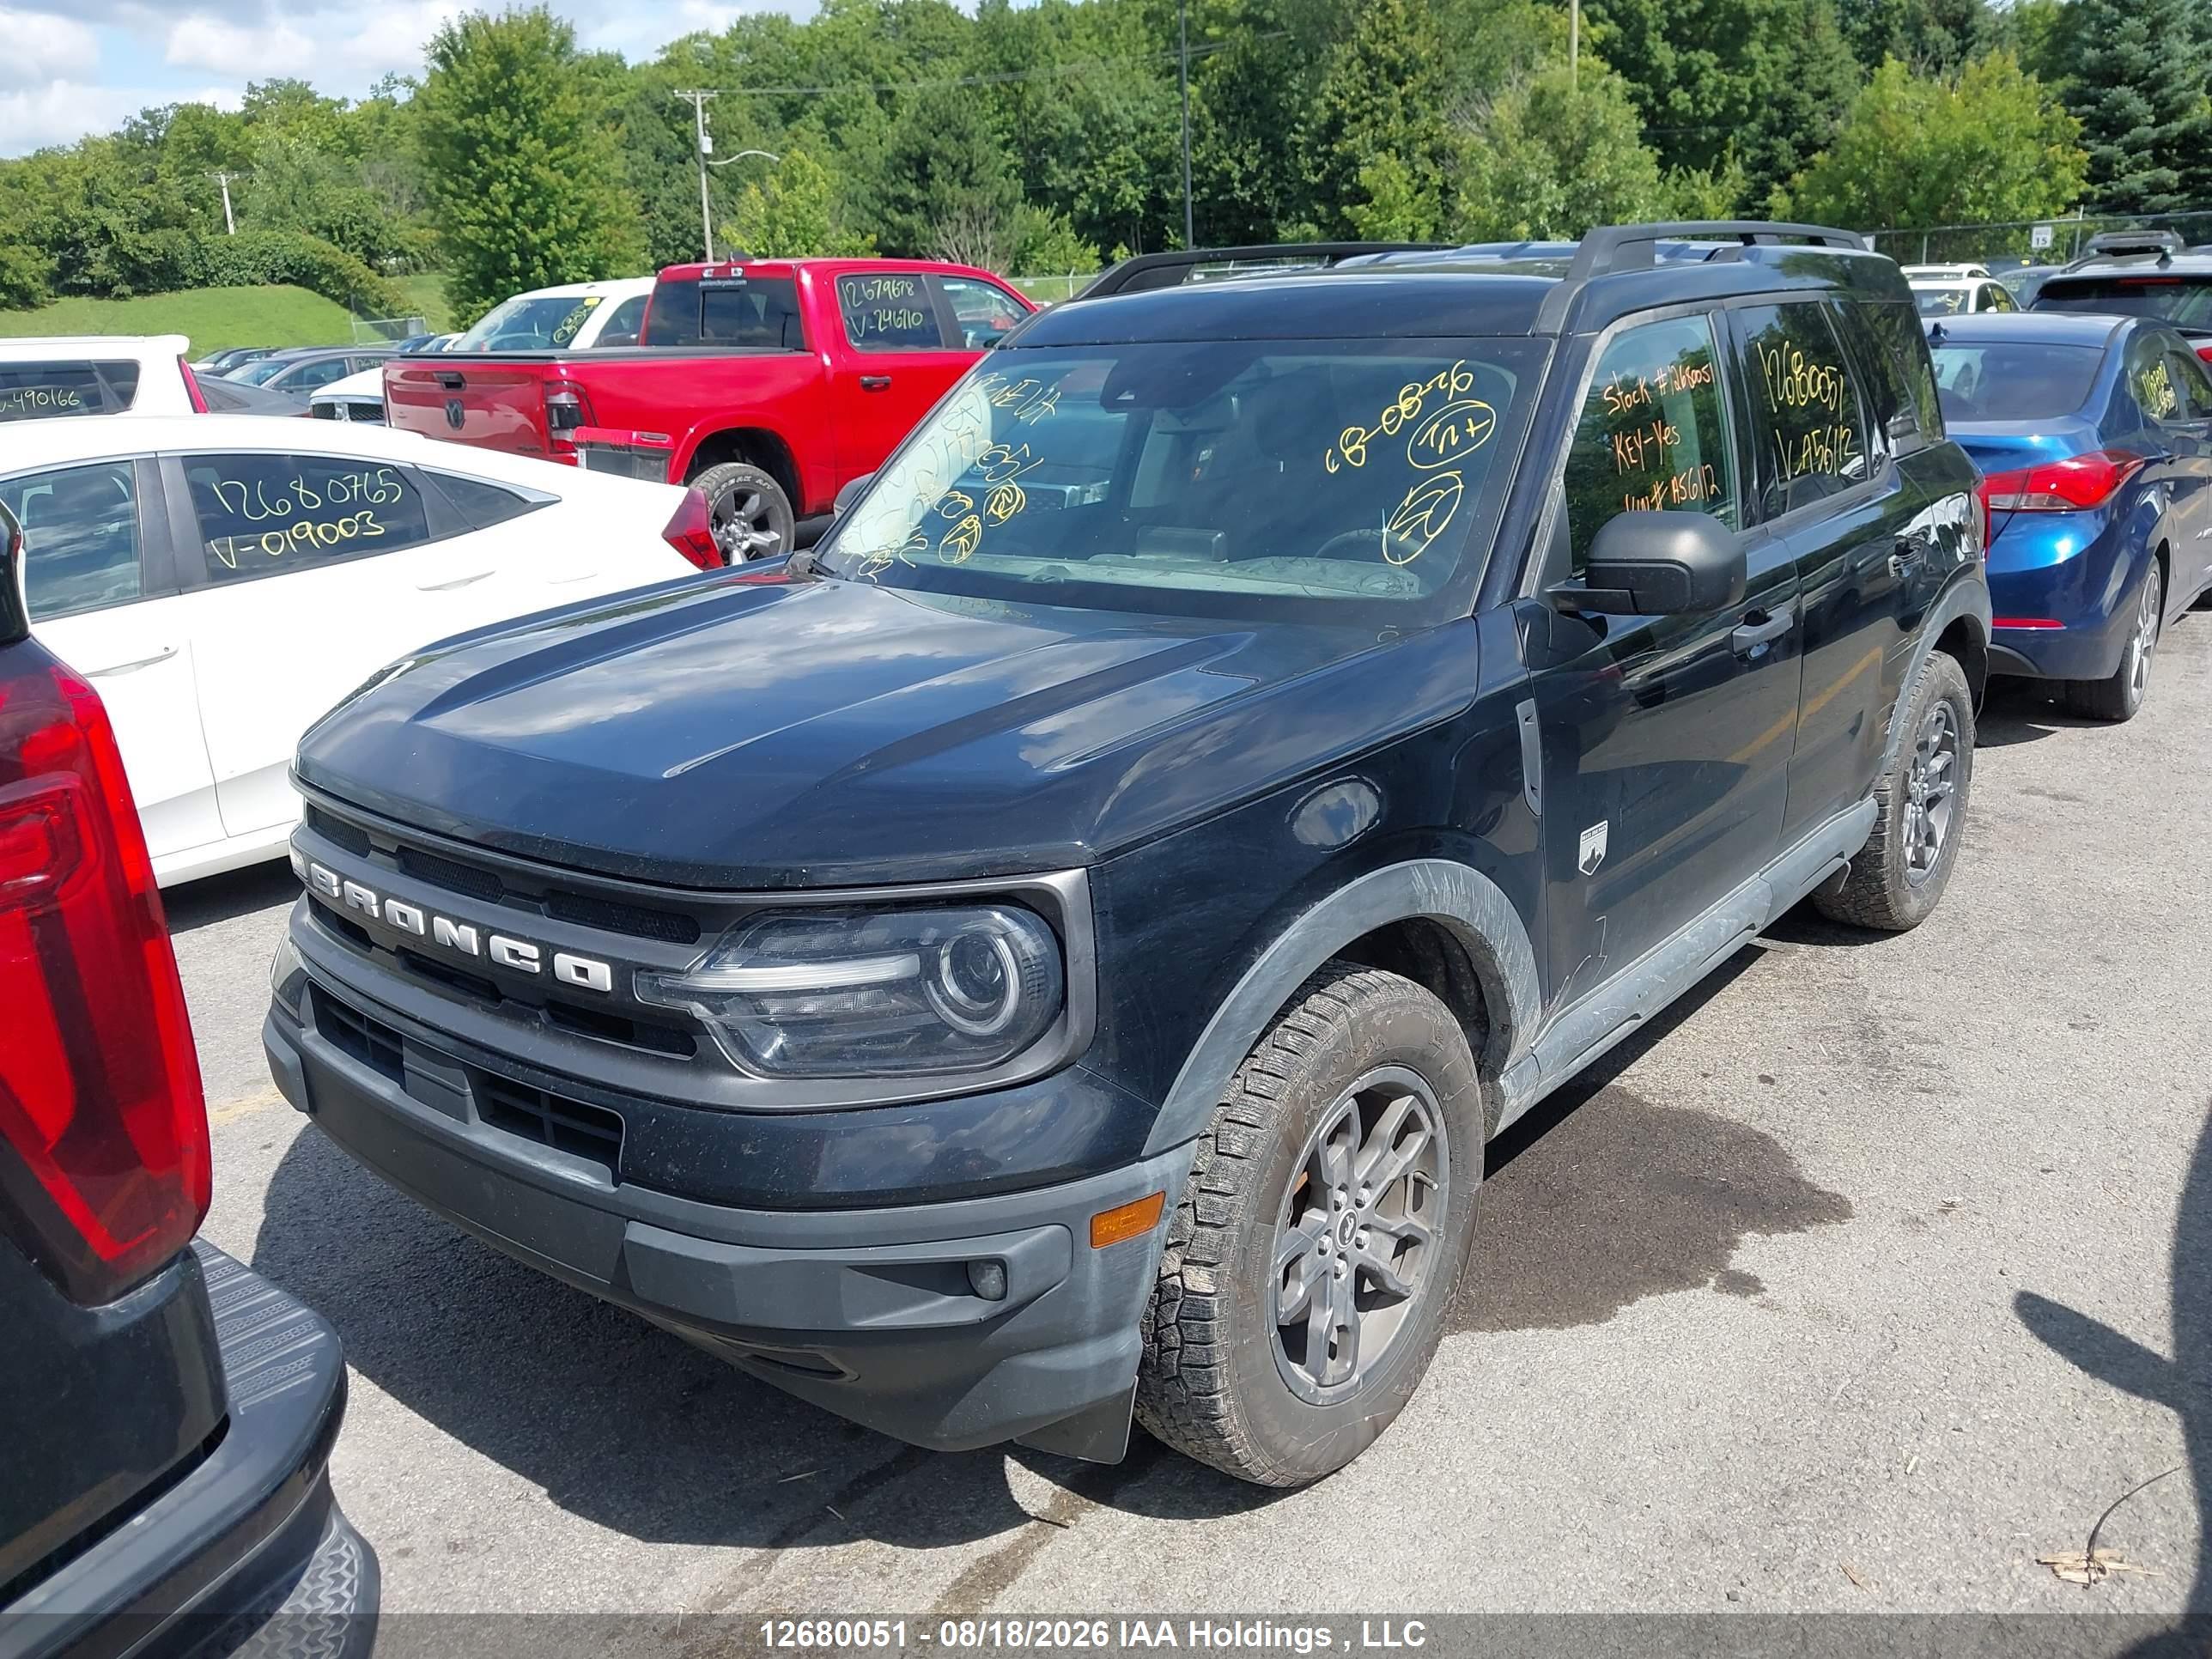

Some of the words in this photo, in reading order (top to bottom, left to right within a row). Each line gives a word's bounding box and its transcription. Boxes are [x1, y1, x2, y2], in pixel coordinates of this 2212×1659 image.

[1757, 341, 1844, 421] 12680051
[212, 469, 403, 520] 12680765
[210, 511, 386, 568] V-019003
[310, 862, 612, 993] BRONCO
